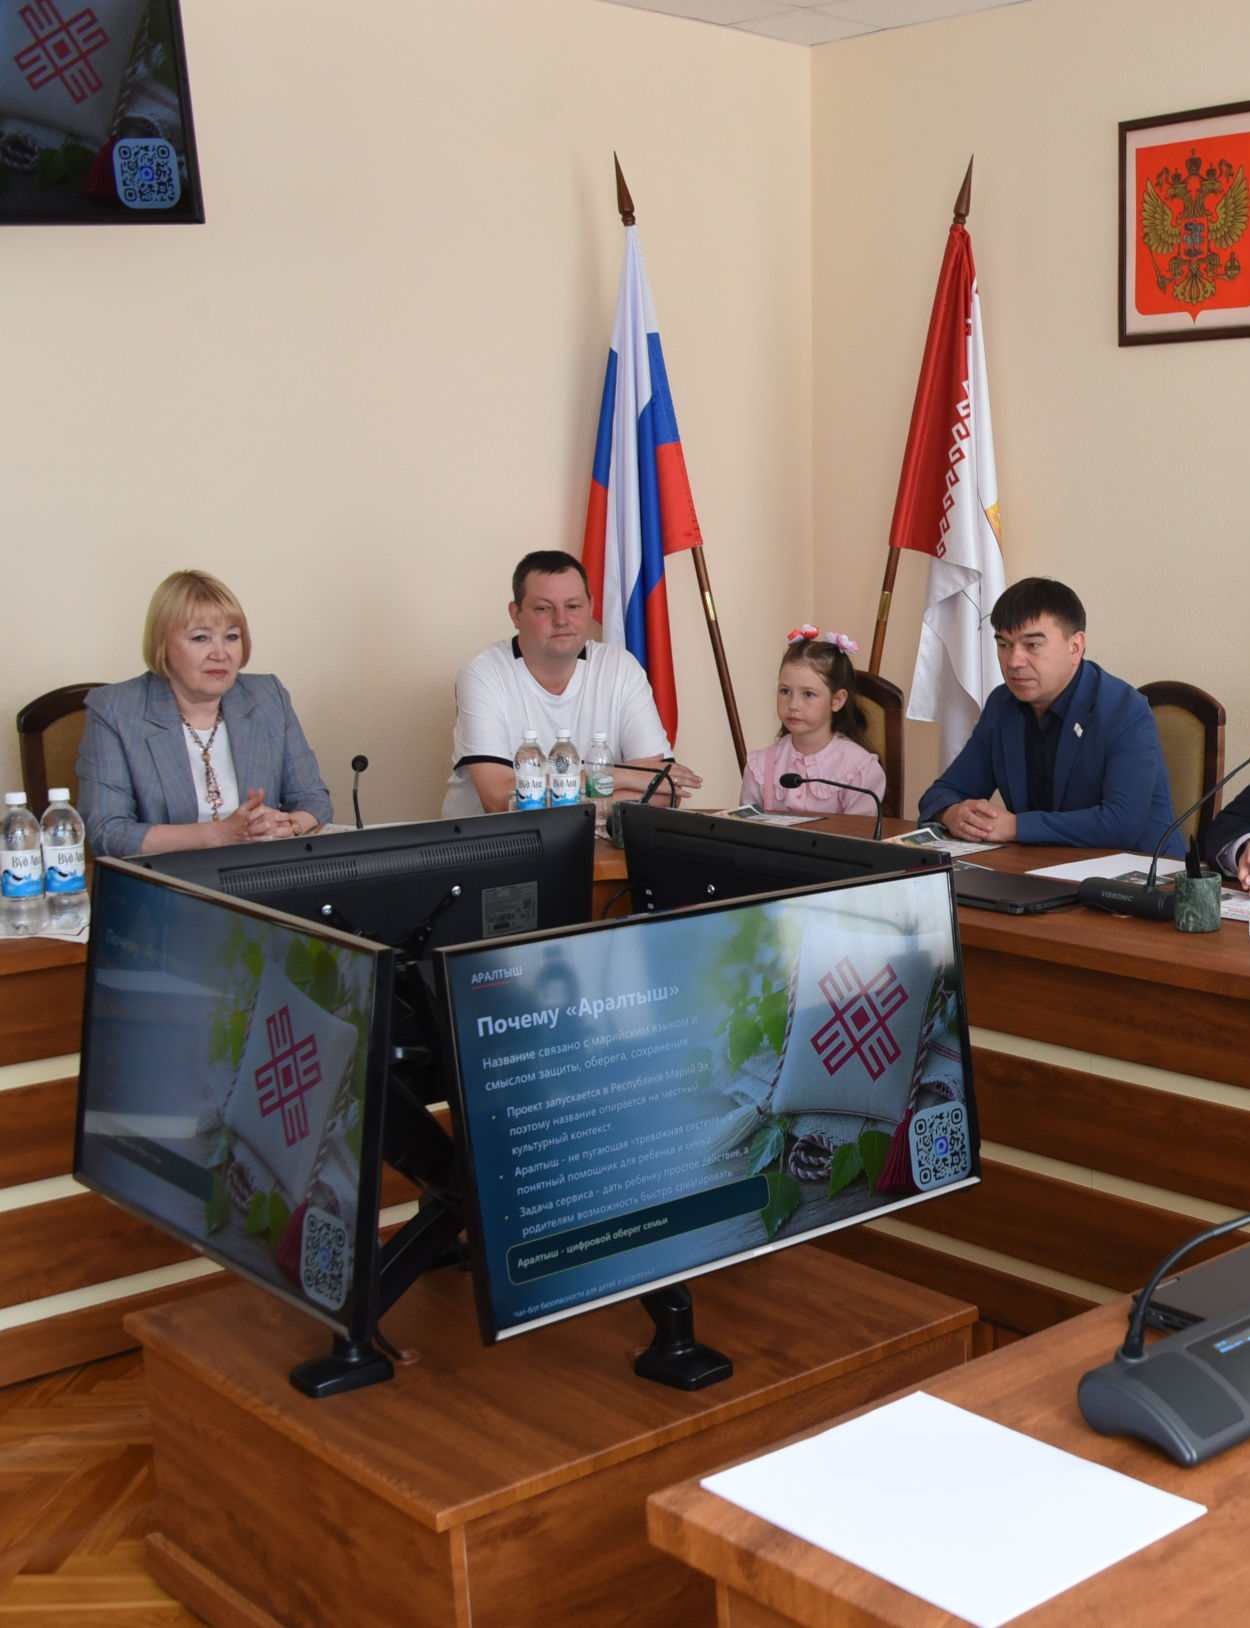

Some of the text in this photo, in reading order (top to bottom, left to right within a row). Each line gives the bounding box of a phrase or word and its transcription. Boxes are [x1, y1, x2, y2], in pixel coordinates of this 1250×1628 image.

[1101, 890, 1134, 903] VISSONIC
[471, 966, 523, 984] АРАЛТЫШ
[477, 985, 679, 1037] Почему «Аралтыш»
[482, 1050, 535, 1069] Название
[538, 1040, 580, 1057] связано
[591, 1026, 649, 1046] марийским
[652, 1017, 688, 1032] языком
[485, 1038, 690, 1091] смыслом защиты, оберега, сохранения.
[506, 1101, 542, 1118] Проект
[545, 1088, 600, 1108] запускается
[610, 1074, 663, 1092] Республике
[665, 1064, 695, 1079] Марий
[697, 1062, 710, 1072] Эл,
[509, 1119, 550, 1136] поэтому
[552, 1108, 596, 1125] название
[598, 1096, 646, 1114] опирается
[661, 1081, 699, 1098] местный
[511, 1123, 614, 1157] культурный контекст.
